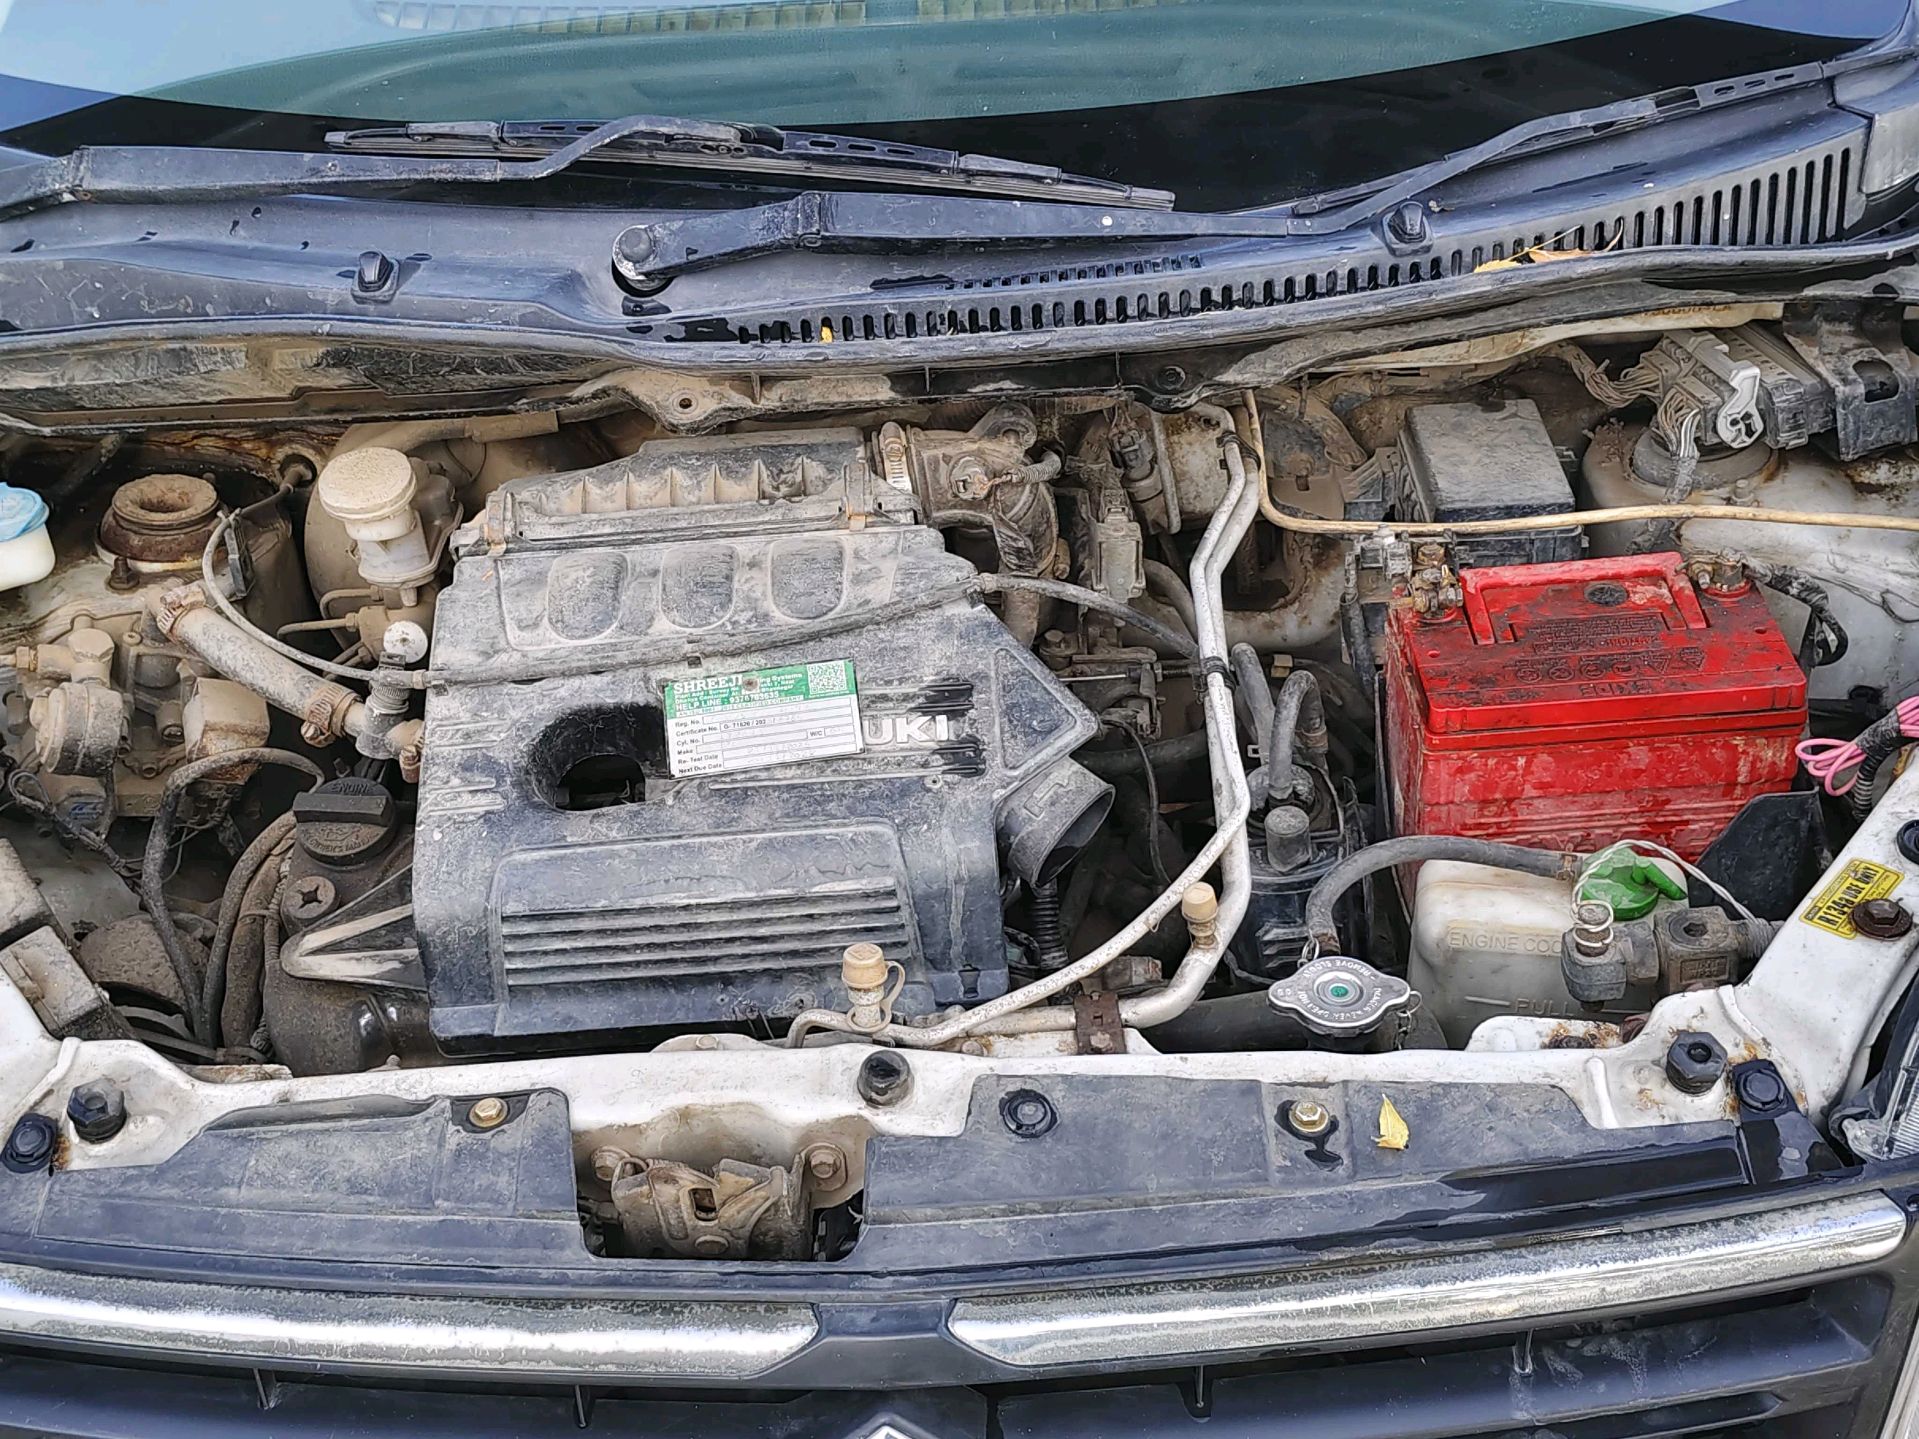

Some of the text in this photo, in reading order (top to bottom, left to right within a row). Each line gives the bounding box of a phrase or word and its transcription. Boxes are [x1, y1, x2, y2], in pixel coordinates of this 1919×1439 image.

[674, 674, 743, 694] SHREEJI
[676, 701, 700, 712] HELP
[702, 698, 722, 708] LINE
[863, 714, 948, 744] UKI
[678, 766, 694, 775] Next
[708, 762, 722, 770] Date
[1816, 896, 1855, 927] R134a
[1841, 882, 1864, 899] USE
[1448, 932, 1519, 950] ENGINE
